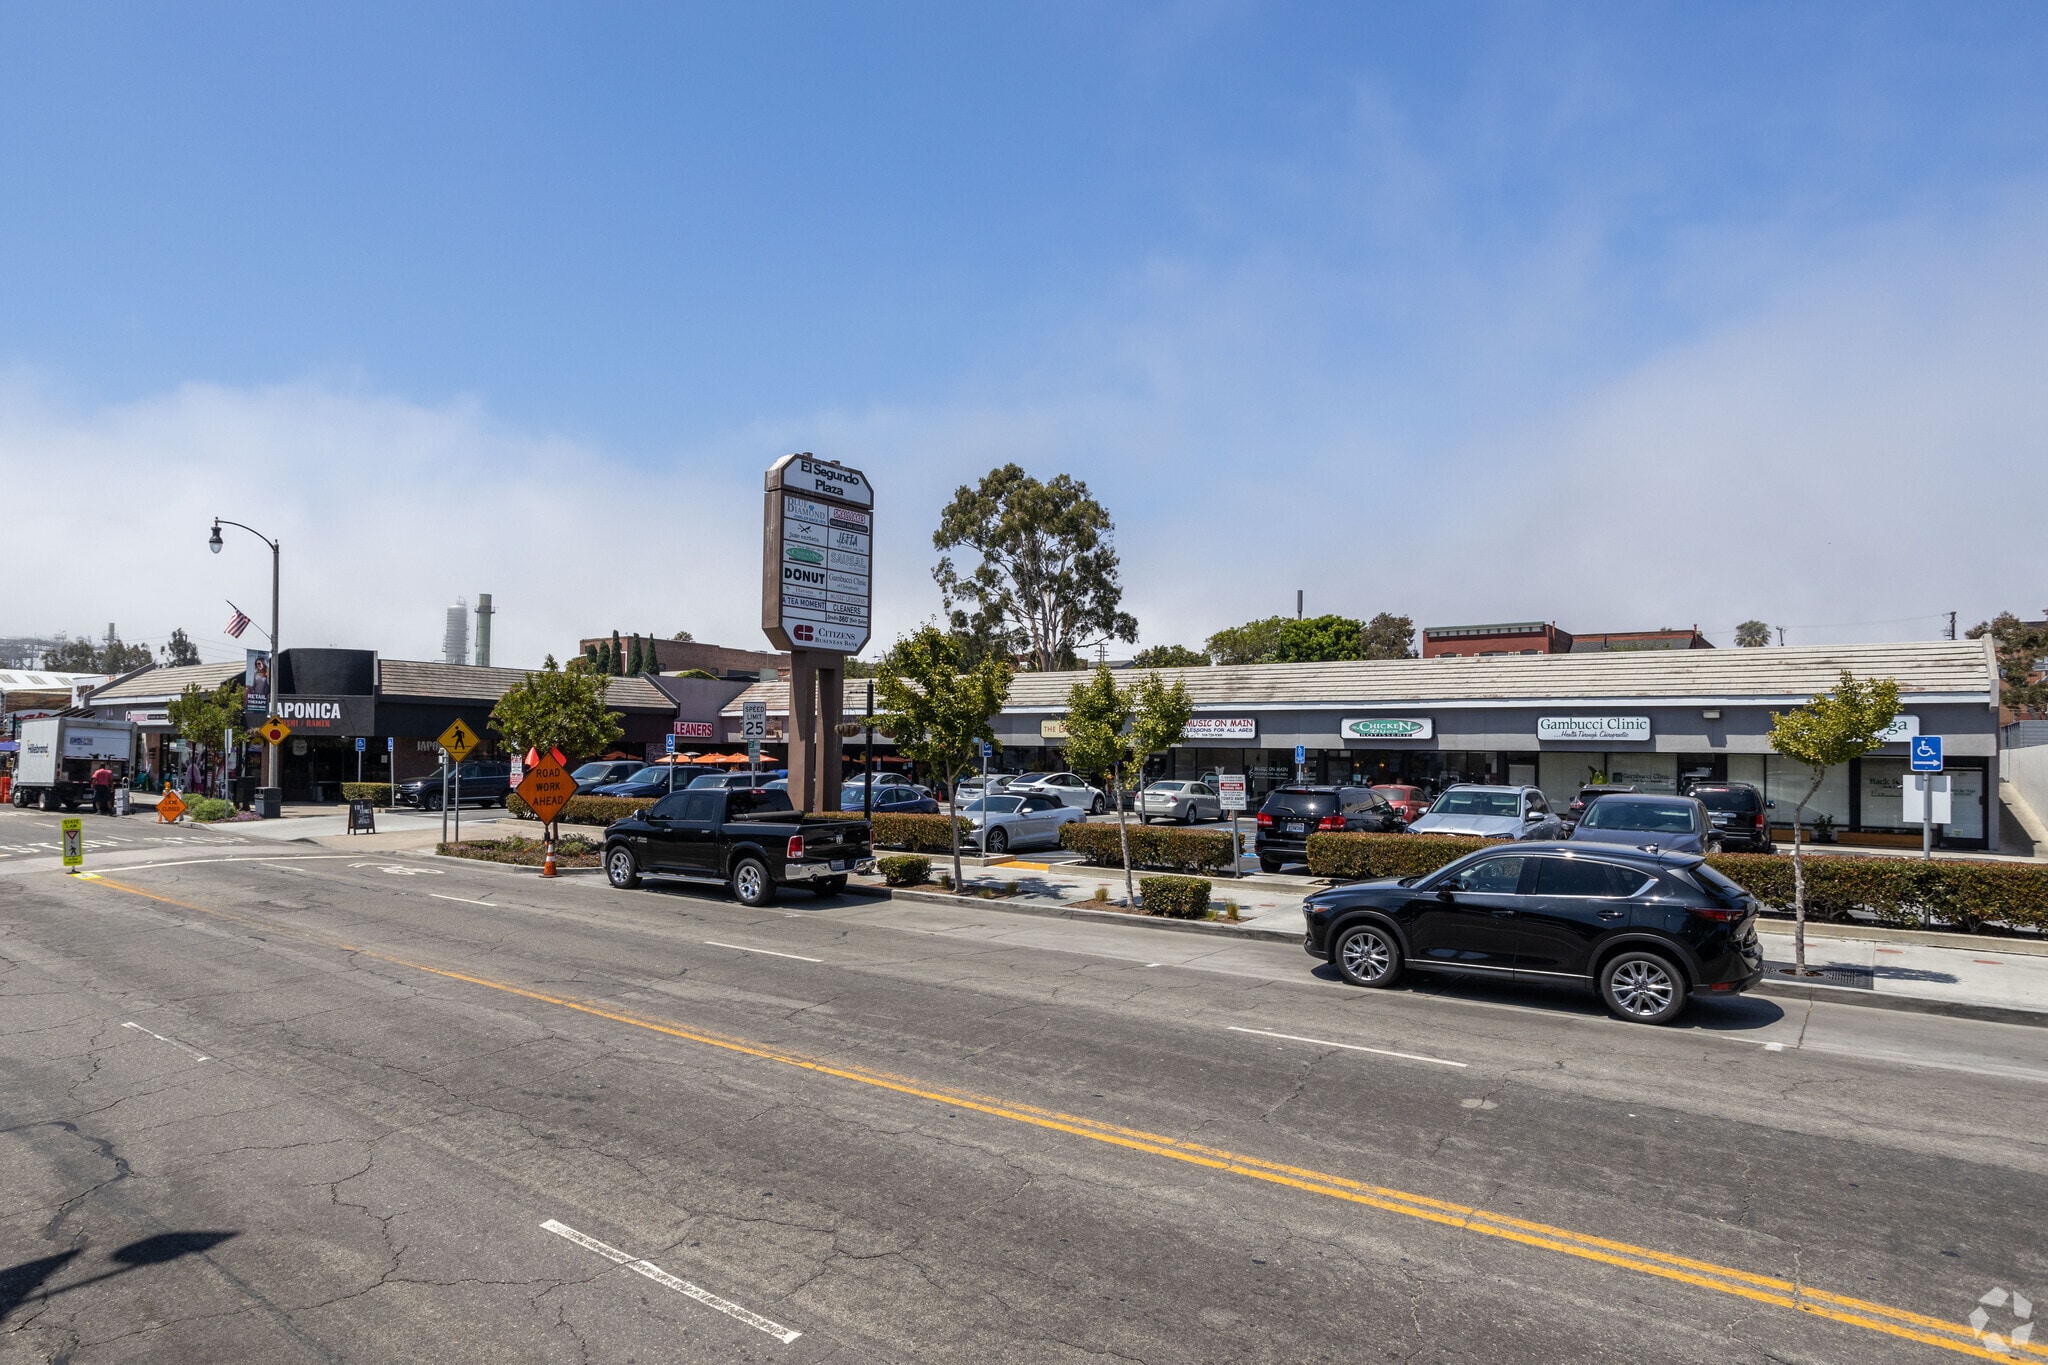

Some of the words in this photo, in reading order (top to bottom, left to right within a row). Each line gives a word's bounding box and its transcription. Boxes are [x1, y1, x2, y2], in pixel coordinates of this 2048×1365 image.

[801, 461, 812, 474] El
[814, 464, 859, 485] Segundo
[815, 479, 843, 496] Plaza
[787, 505, 825, 520] DIAMOND
[784, 567, 825, 584] DONUT
[829, 573, 853, 584] Gambucci
[788, 597, 799, 605] TEA
[800, 599, 825, 609] MOMENT
[833, 604, 861, 614] CLEANERS
[818, 628, 855, 640] CITIZENS
[815, 637, 843, 646] BUSINESS
[674, 722, 712, 736] LEANERS
[746, 722, 764, 735] 25
[1230, 719, 1253, 727] MAIN
[1360, 721, 1411, 731] CHICKEN
[1540, 718, 1603, 730] Gambucci
[1607, 718, 1647, 730] Clinic
[536, 768, 560, 778] ROAD
[536, 782, 561, 792] WORK
[532, 795, 563, 806] AHEAD
